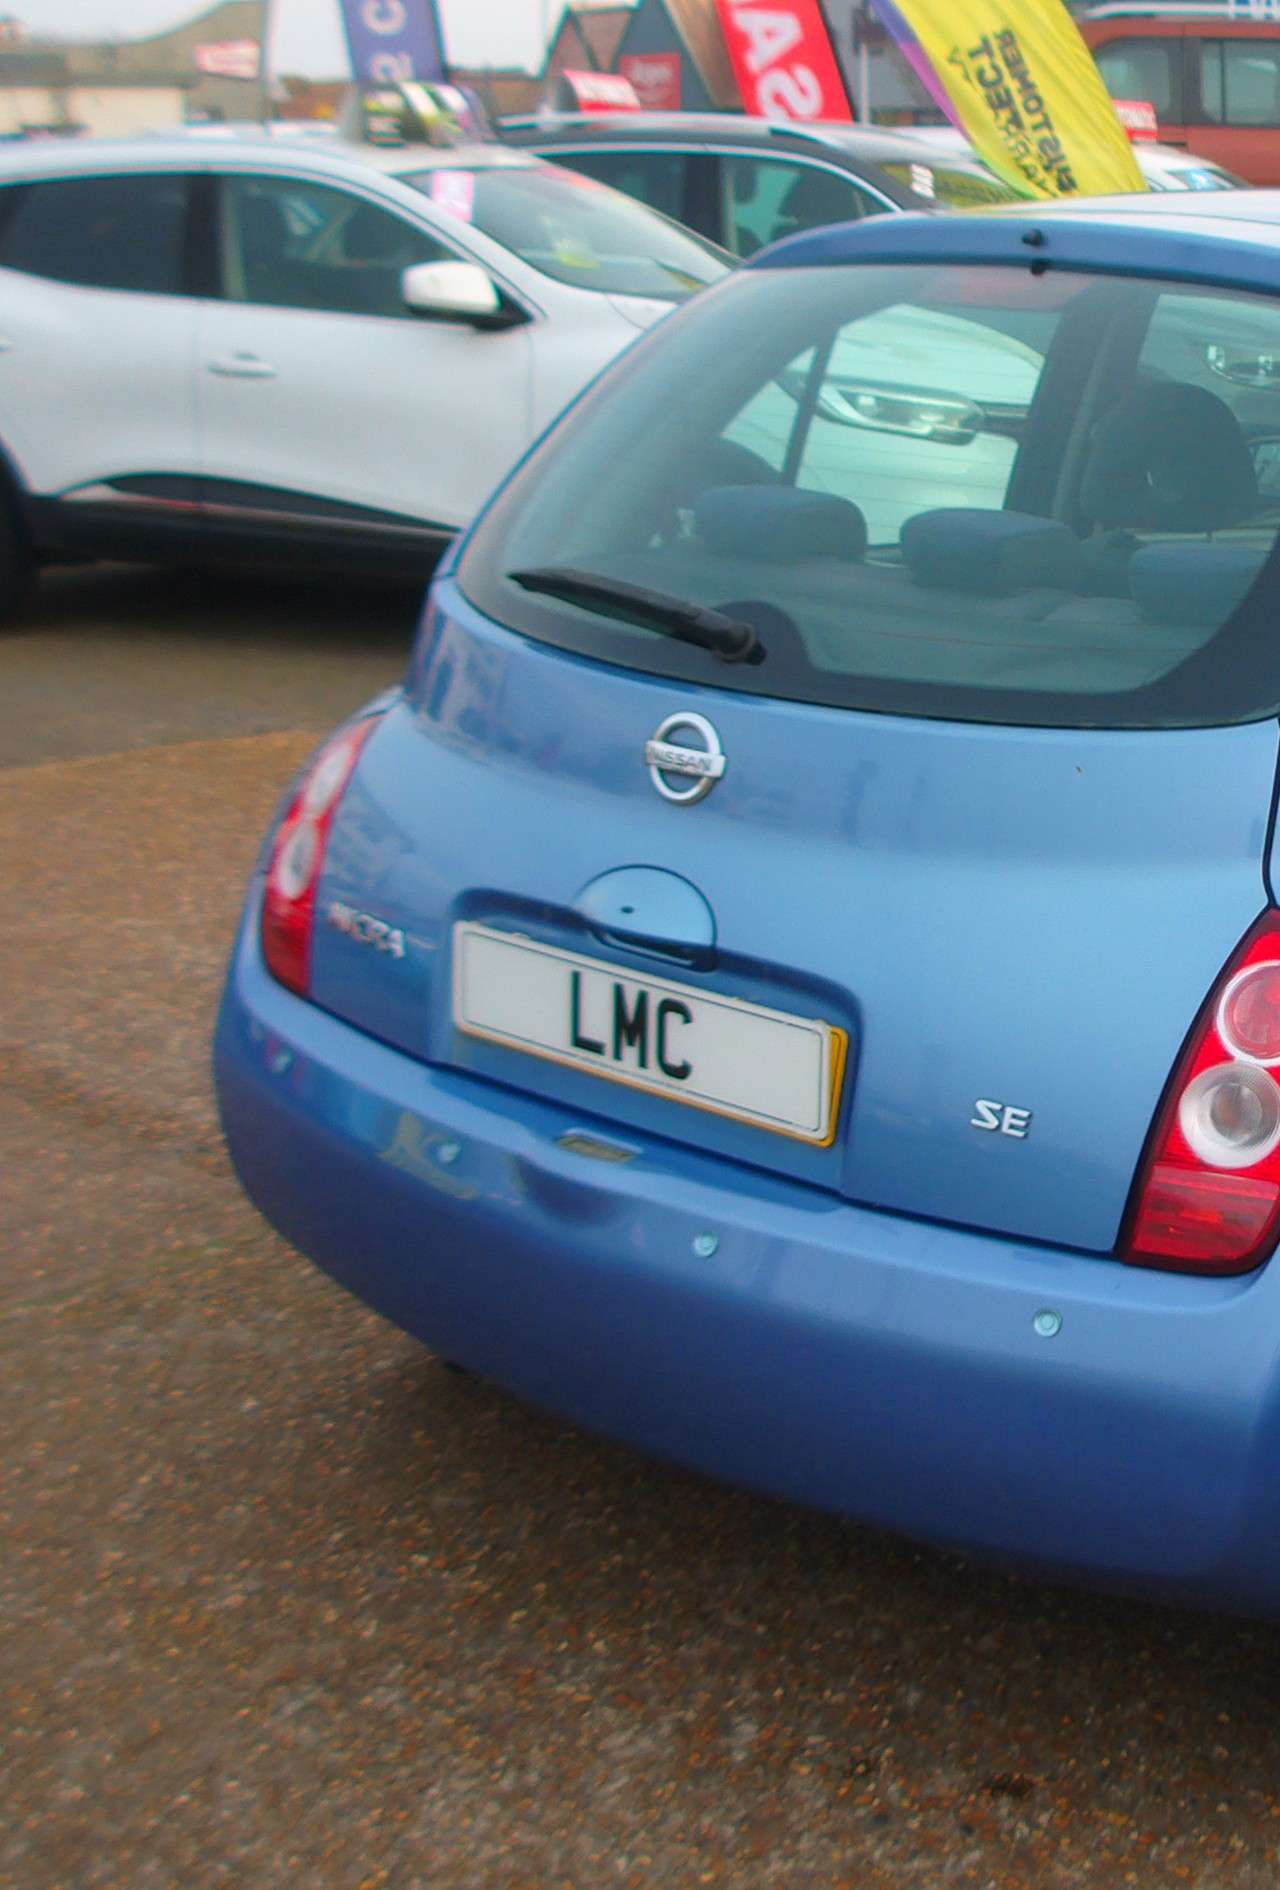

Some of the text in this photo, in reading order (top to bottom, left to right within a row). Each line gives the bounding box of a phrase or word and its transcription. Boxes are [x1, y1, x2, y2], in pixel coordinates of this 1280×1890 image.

[646, 747, 712, 772] NISSAN
[571, 970, 693, 1081] LMC
[970, 1099, 1032, 1138] SE
